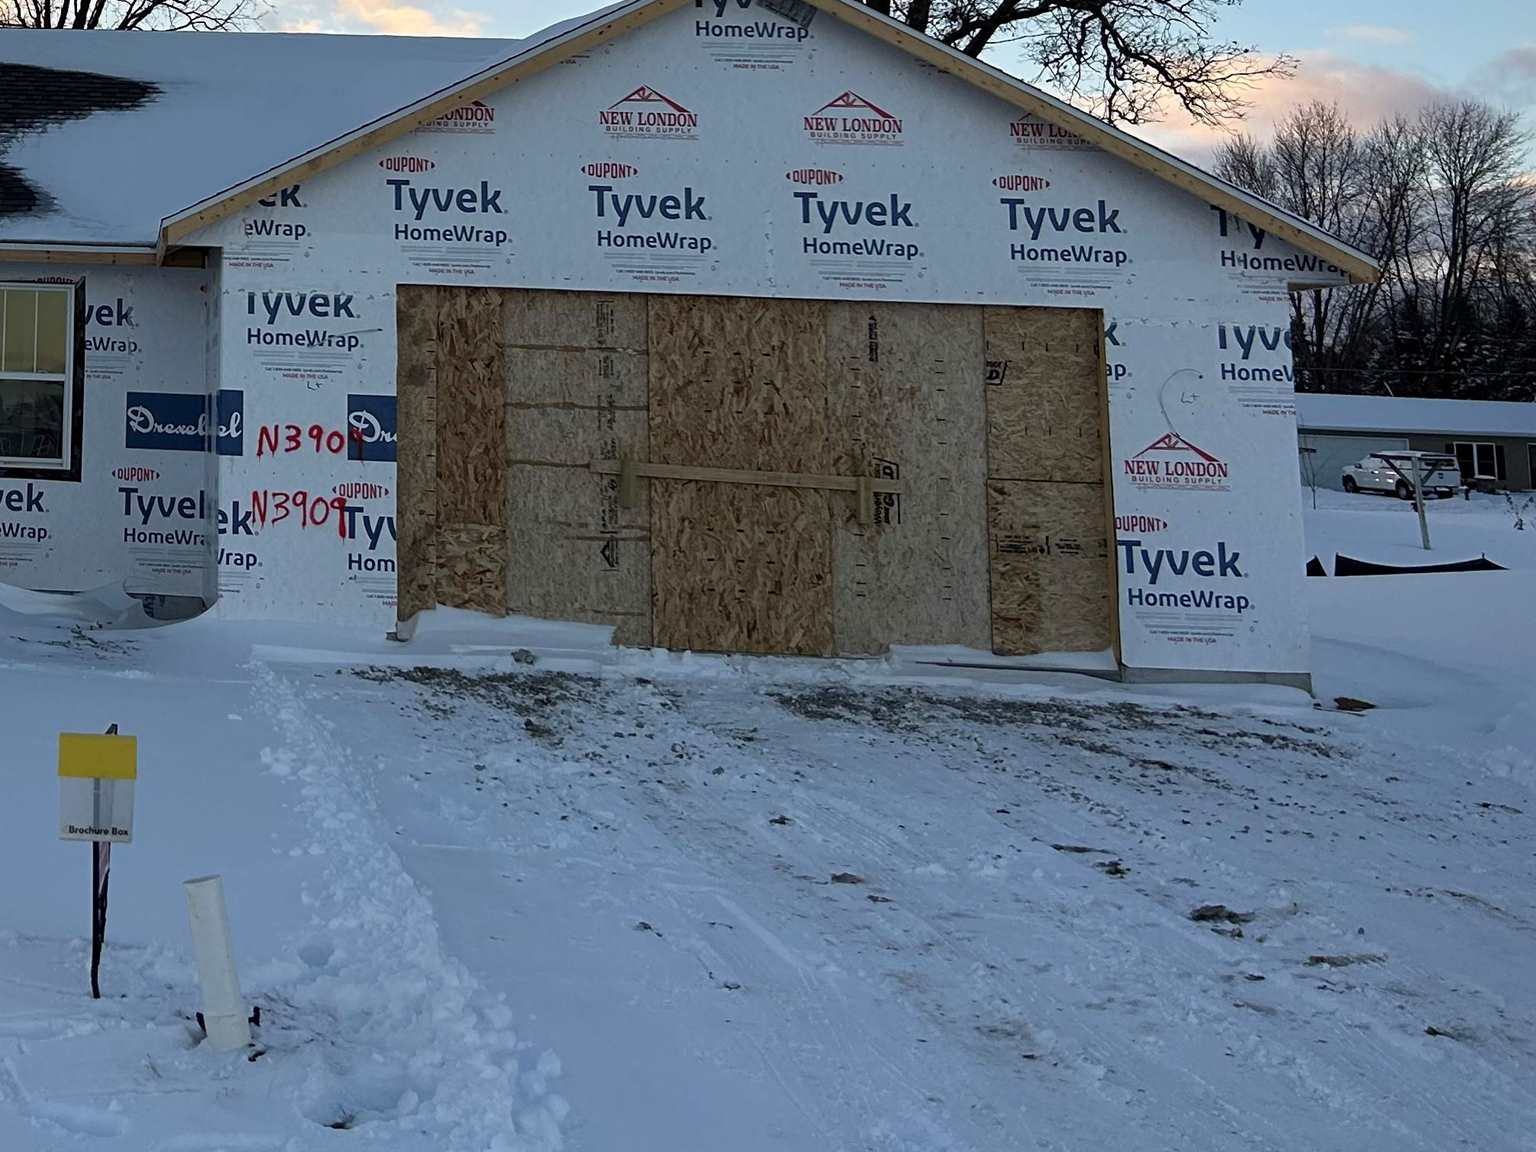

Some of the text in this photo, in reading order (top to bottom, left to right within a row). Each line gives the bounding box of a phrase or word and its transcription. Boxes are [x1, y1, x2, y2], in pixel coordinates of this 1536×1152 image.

[695, 20, 809, 42] HomeWrap
[600, 111, 698, 127] NEW LONDON
[804, 117, 903, 134] NEW LONDON
[656, 126, 692, 134] SUPPLY
[1010, 123, 1044, 137] NEW
[1017, 137, 1063, 145] BUILDING
[386, 157, 429, 173] DUPONT
[588, 163, 632, 178] DUPONT
[793, 169, 837, 185] DUPONT
[999, 175, 1044, 191] DUPONT
[386, 179, 503, 221] Tyvek
[588, 186, 706, 227] Tyvek
[793, 192, 914, 234] Tyvek
[1000, 198, 1121, 240] Tyvek
[395, 223, 507, 246] HomeWrap
[597, 230, 712, 253] HomeWrap
[803, 237, 919, 260] HomeWrap
[1010, 244, 1128, 267] HomeWrap
[247, 292, 354, 324] Tyvek
[247, 328, 360, 351] HomeWrap
[118, 467, 155, 482] DUPONT
[1125, 460, 1228, 477] NEW LONDON
[1185, 477, 1222, 485] SUPPLY
[339, 483, 382, 499] DUPONT
[252, 490, 347, 539] N3909
[1116, 516, 1161, 533] DUPONT
[1118, 540, 1243, 584] Tyvek
[1128, 588, 1250, 613] HomeWrap
[69, 825, 129, 836] Brochure Box
